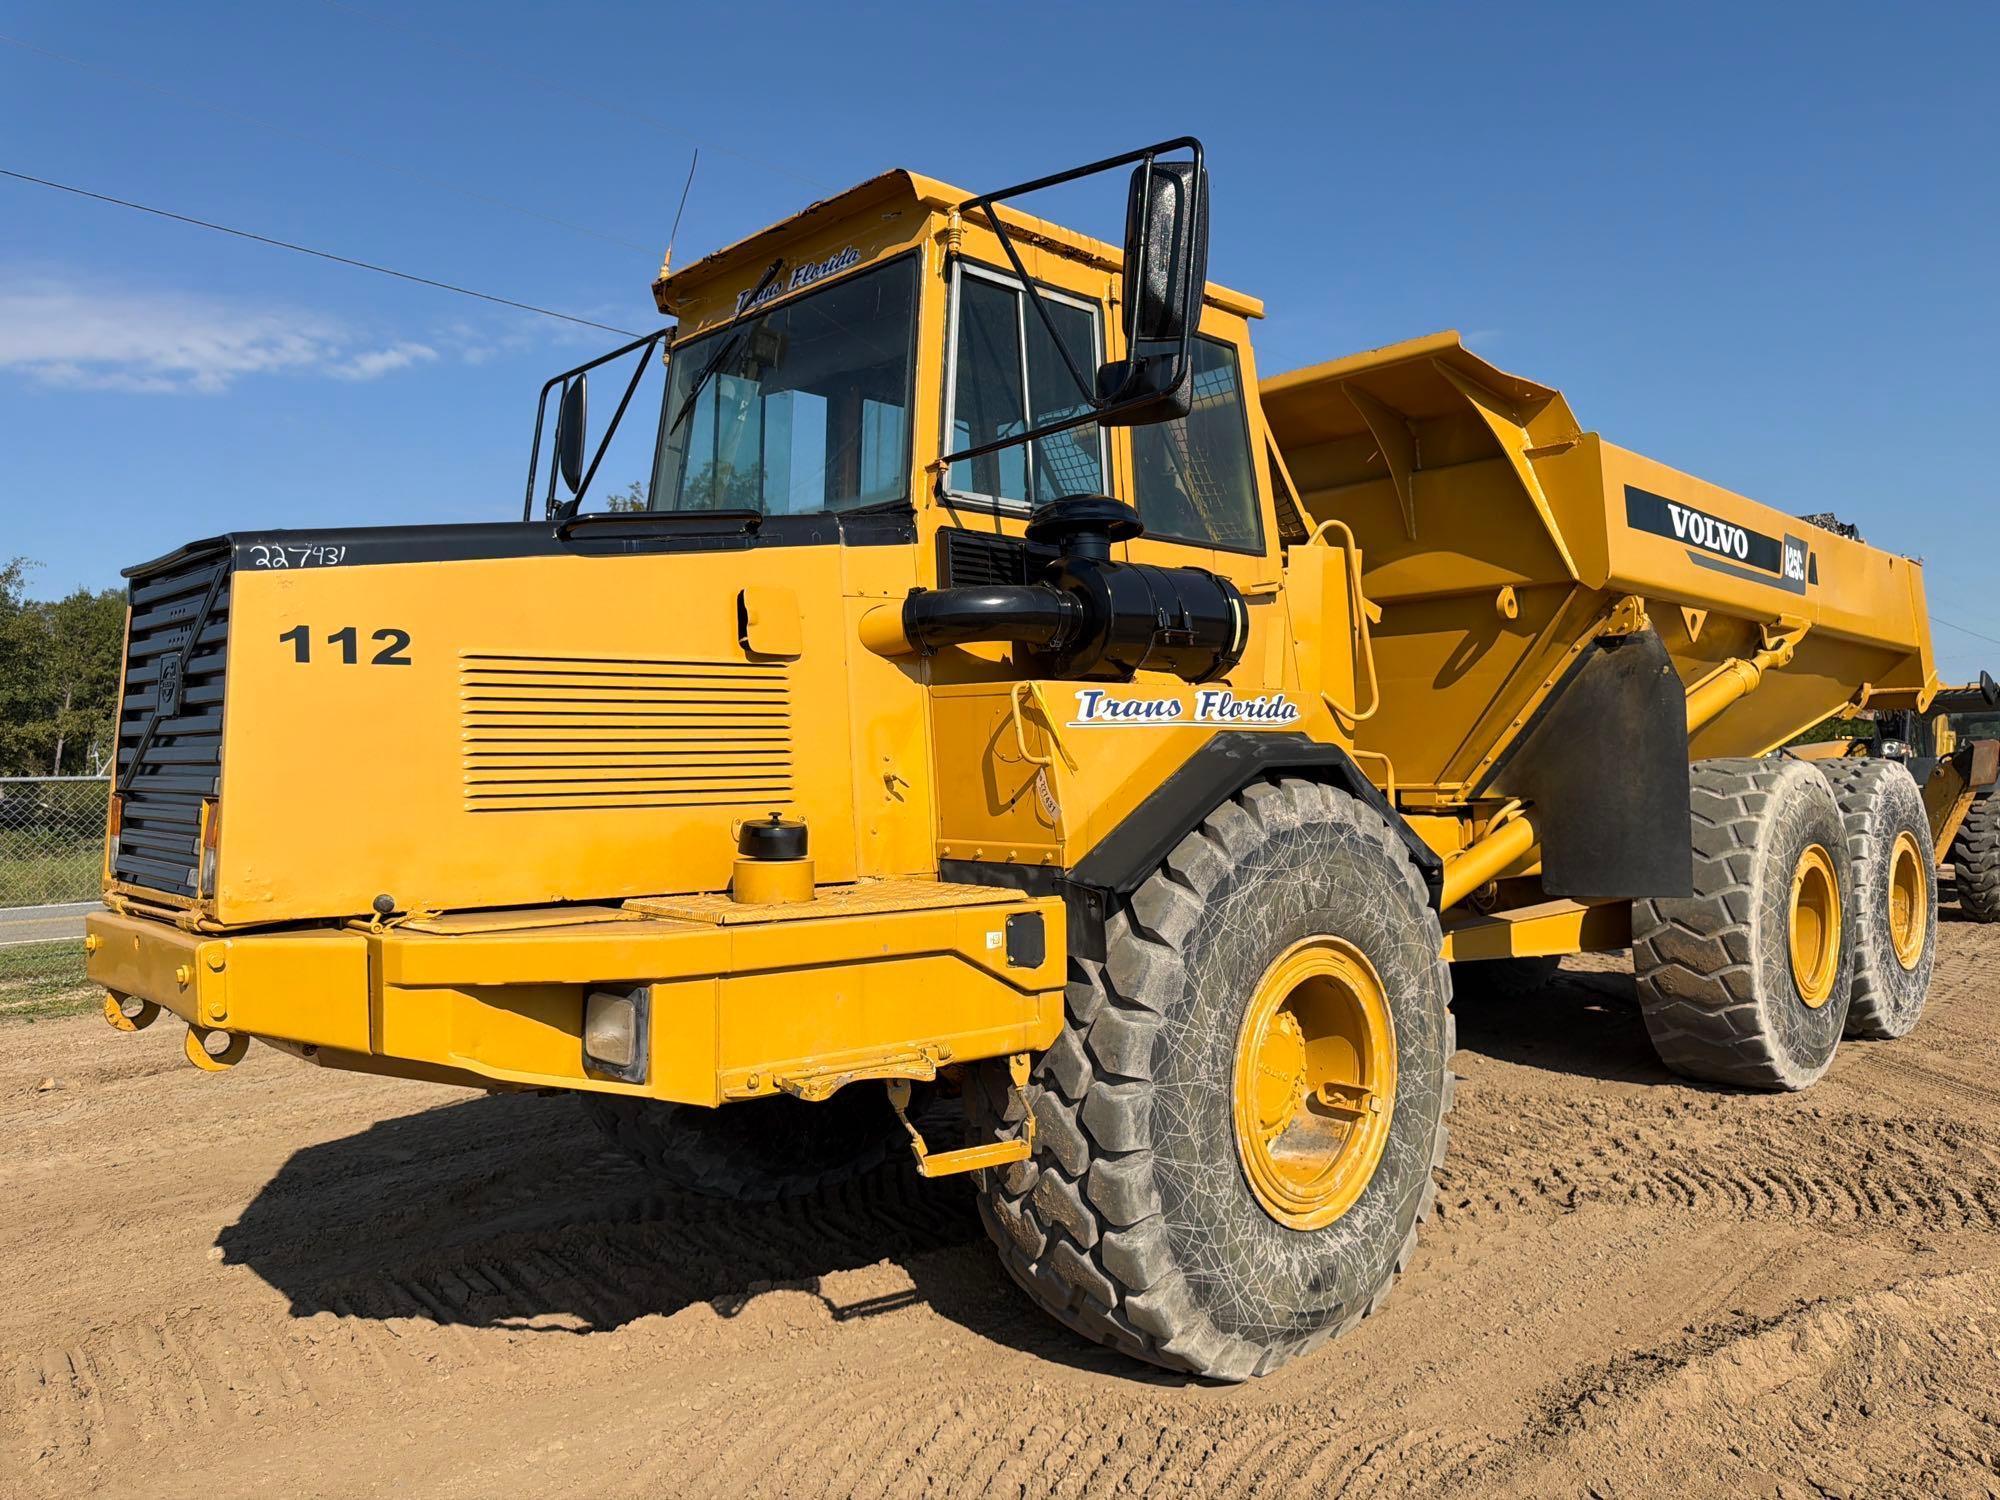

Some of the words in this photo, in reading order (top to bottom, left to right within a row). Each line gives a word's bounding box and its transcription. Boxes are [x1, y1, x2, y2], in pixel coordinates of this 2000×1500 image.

[736, 281, 783, 311] Tans
[789, 246, 859, 290] Florida
[1667, 503, 1749, 560] VOLVO
[249, 544, 346, 568] 227431
[1784, 544, 1804, 581] A25C
[279, 625, 411, 665] 112
[1080, 690, 1182, 719] Trans
[1198, 690, 1299, 720] Florida
